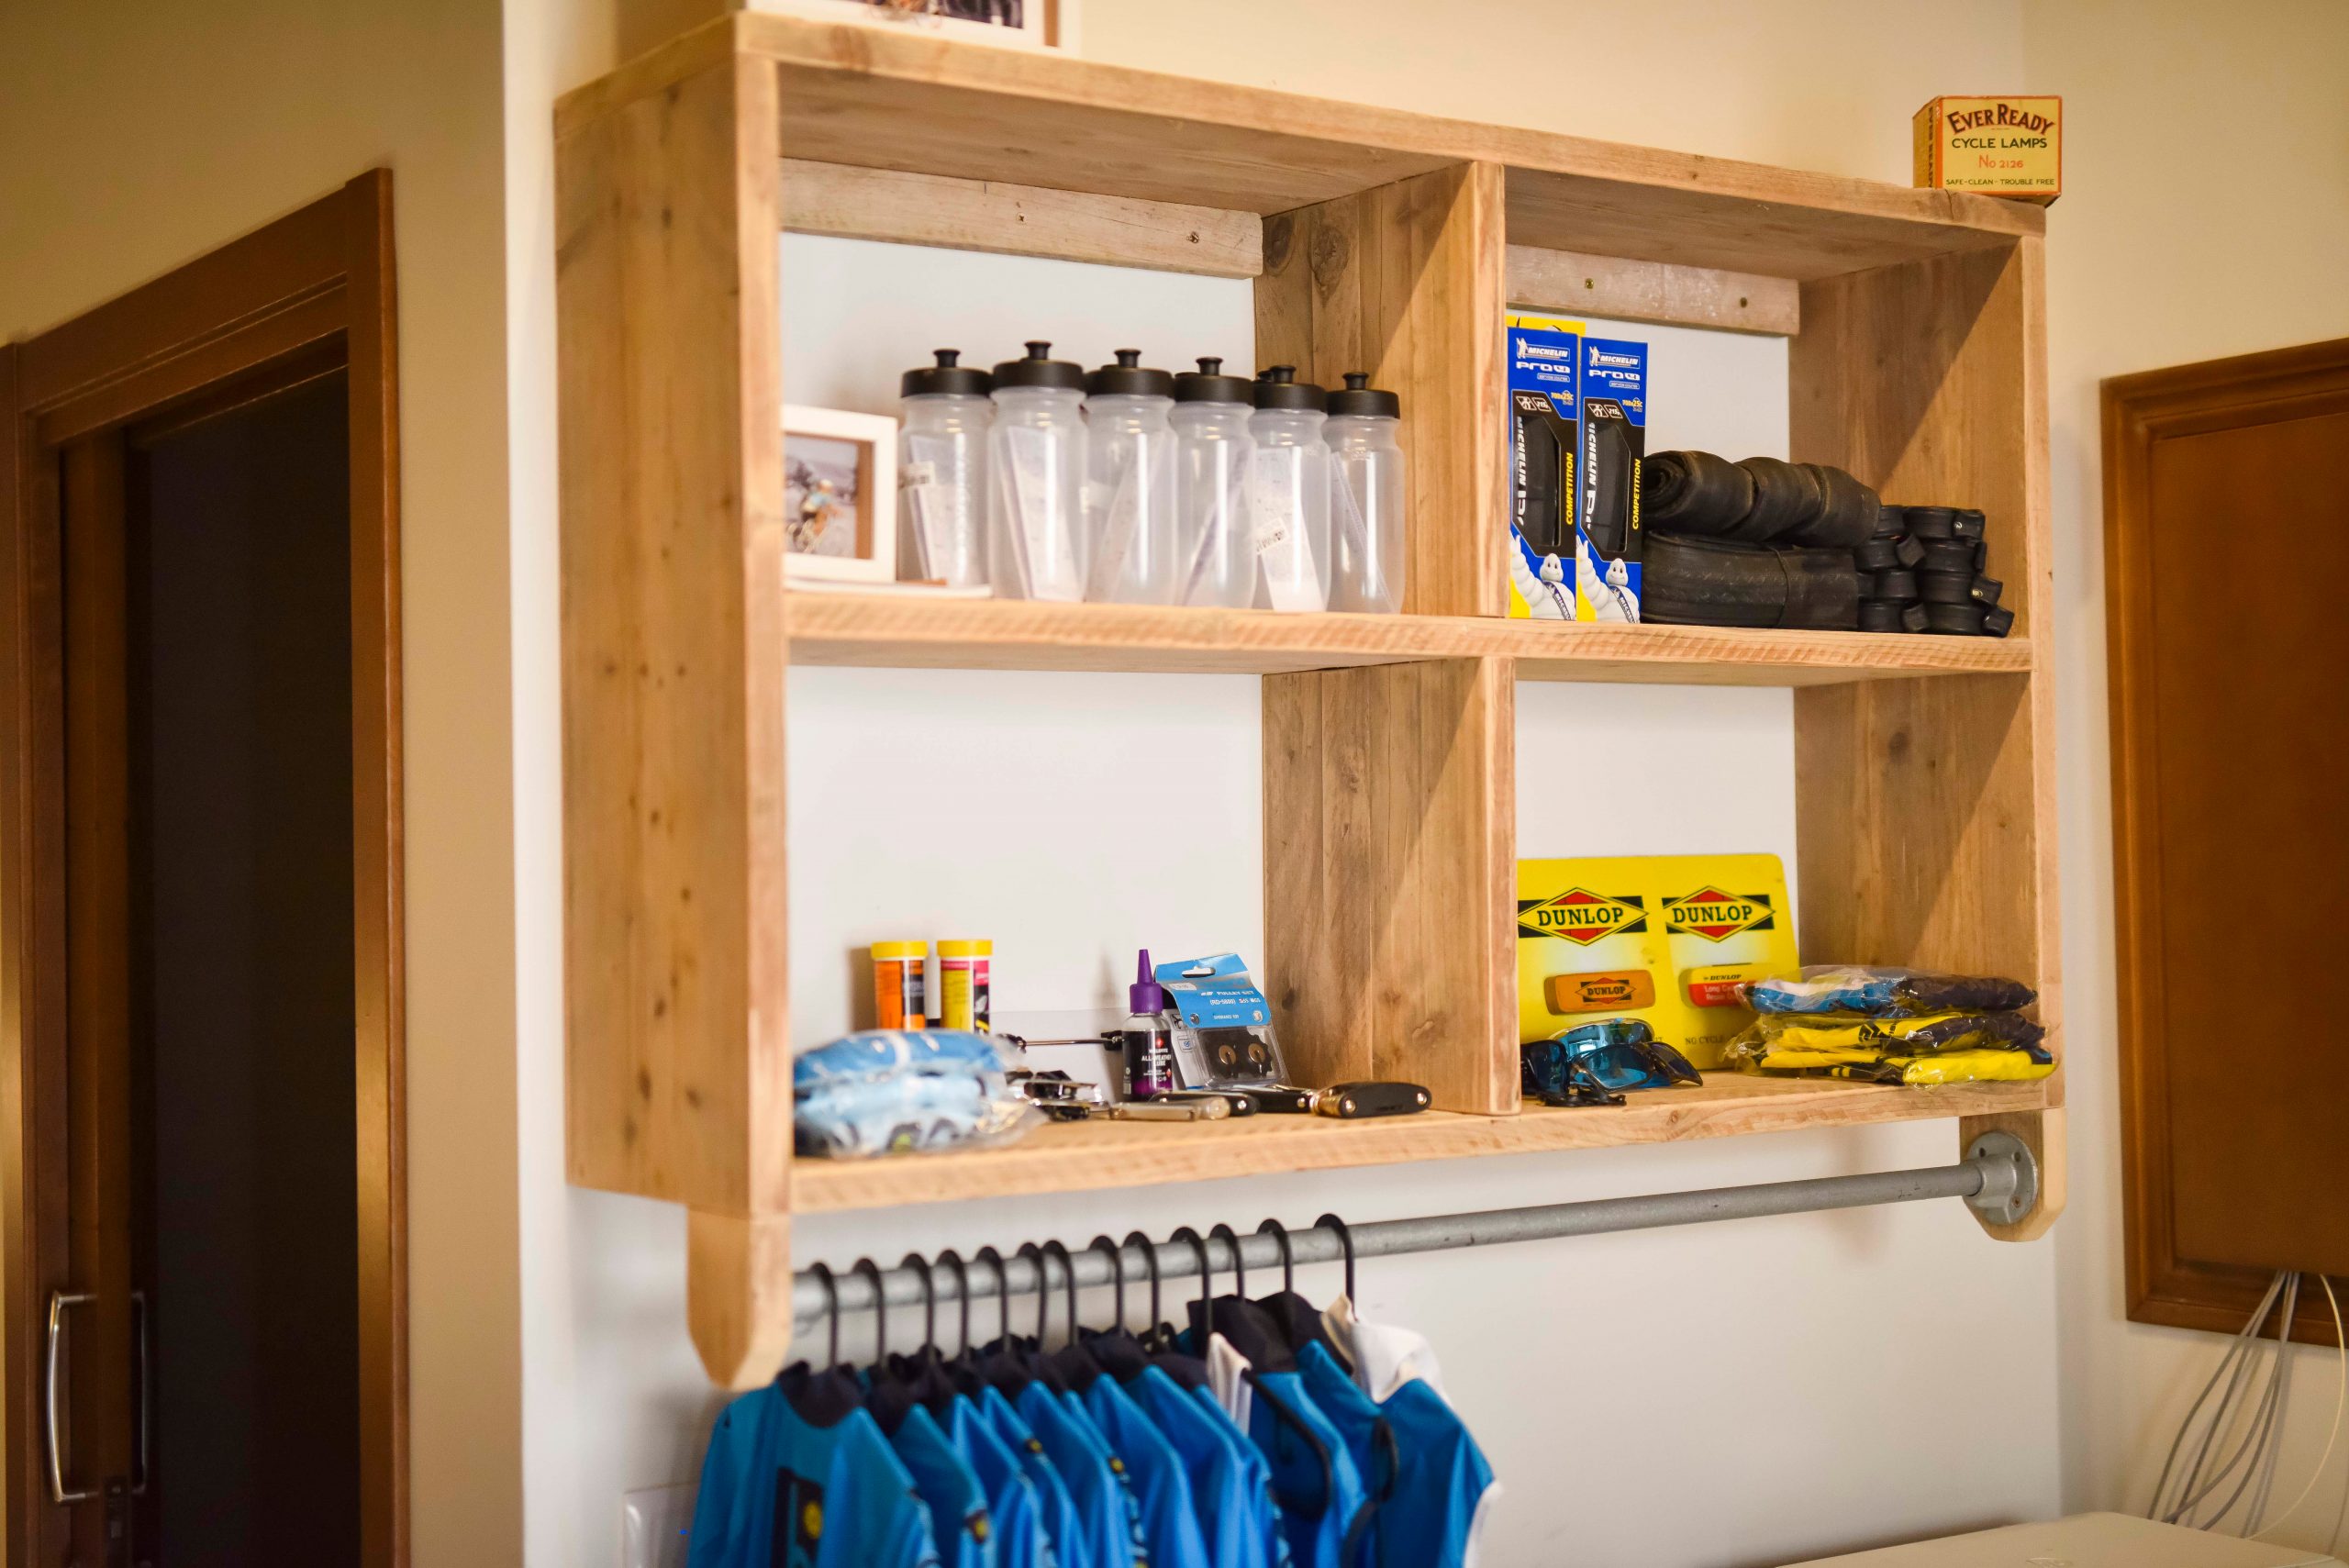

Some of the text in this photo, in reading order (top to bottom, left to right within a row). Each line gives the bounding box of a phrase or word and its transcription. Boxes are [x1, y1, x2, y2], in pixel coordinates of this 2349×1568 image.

[1947, 104, 2055, 135] EVER READY
[1952, 138, 2048, 149] CYCLE LAMPS
[1999, 160, 2024, 169] 2126
[1528, 347, 1568, 358] MICHELIN
[1600, 355, 1639, 365] MICHELIN
[1565, 452, 1574, 526] COMPETITION
[1632, 459, 1641, 530] COMPETITION
[1537, 906, 1624, 927] DUNLOP
[1672, 905, 1753, 923] DUNLOP
[1587, 986, 1626, 995] DUNLOP
